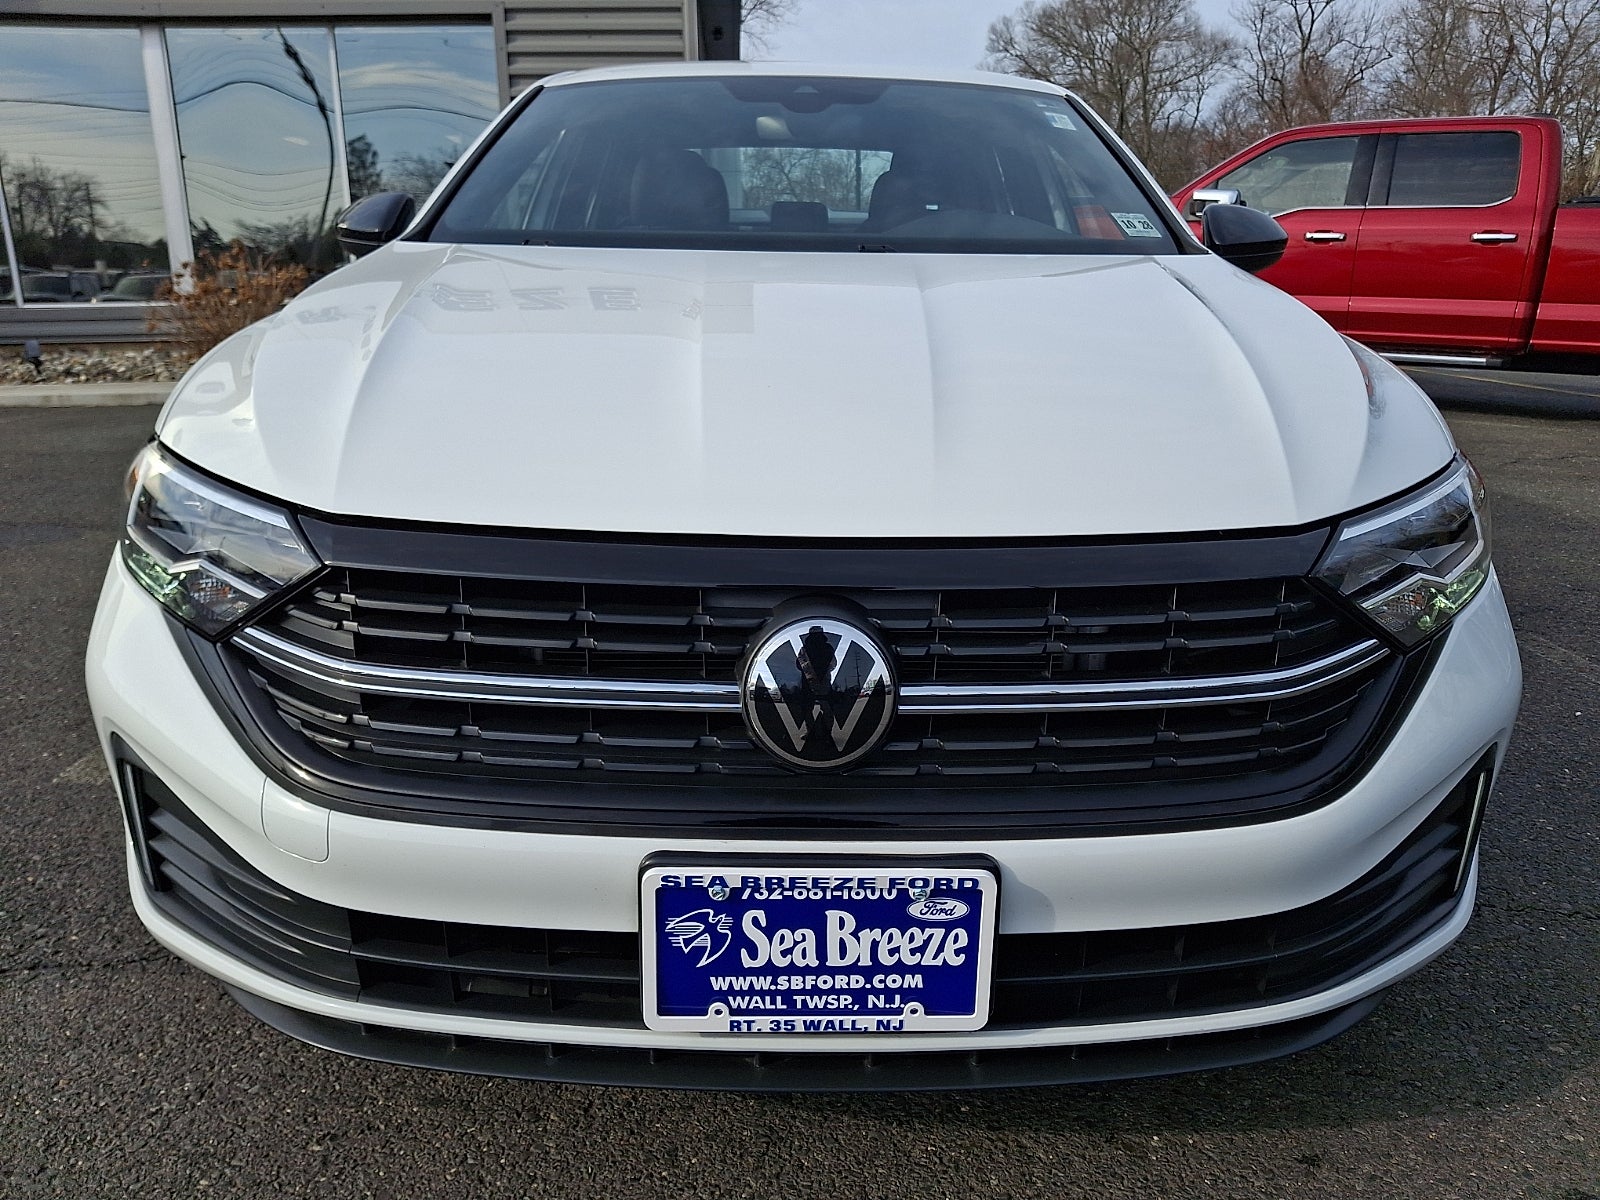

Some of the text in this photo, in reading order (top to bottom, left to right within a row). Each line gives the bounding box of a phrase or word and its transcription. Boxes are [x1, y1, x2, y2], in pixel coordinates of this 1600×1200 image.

[1121, 220, 1137, 229] 10
[660, 875, 980, 890] SEA BREEZE FORD
[919, 900, 958, 917] Ford
[740, 909, 968, 968] Sea Breeze
[710, 974, 924, 991] WWW.SBFORD.COM
[728, 995, 787, 1009] WALL
[867, 994, 906, 1009] N.J.
[729, 1018, 905, 1033] RT. 35 WALL, NJ
